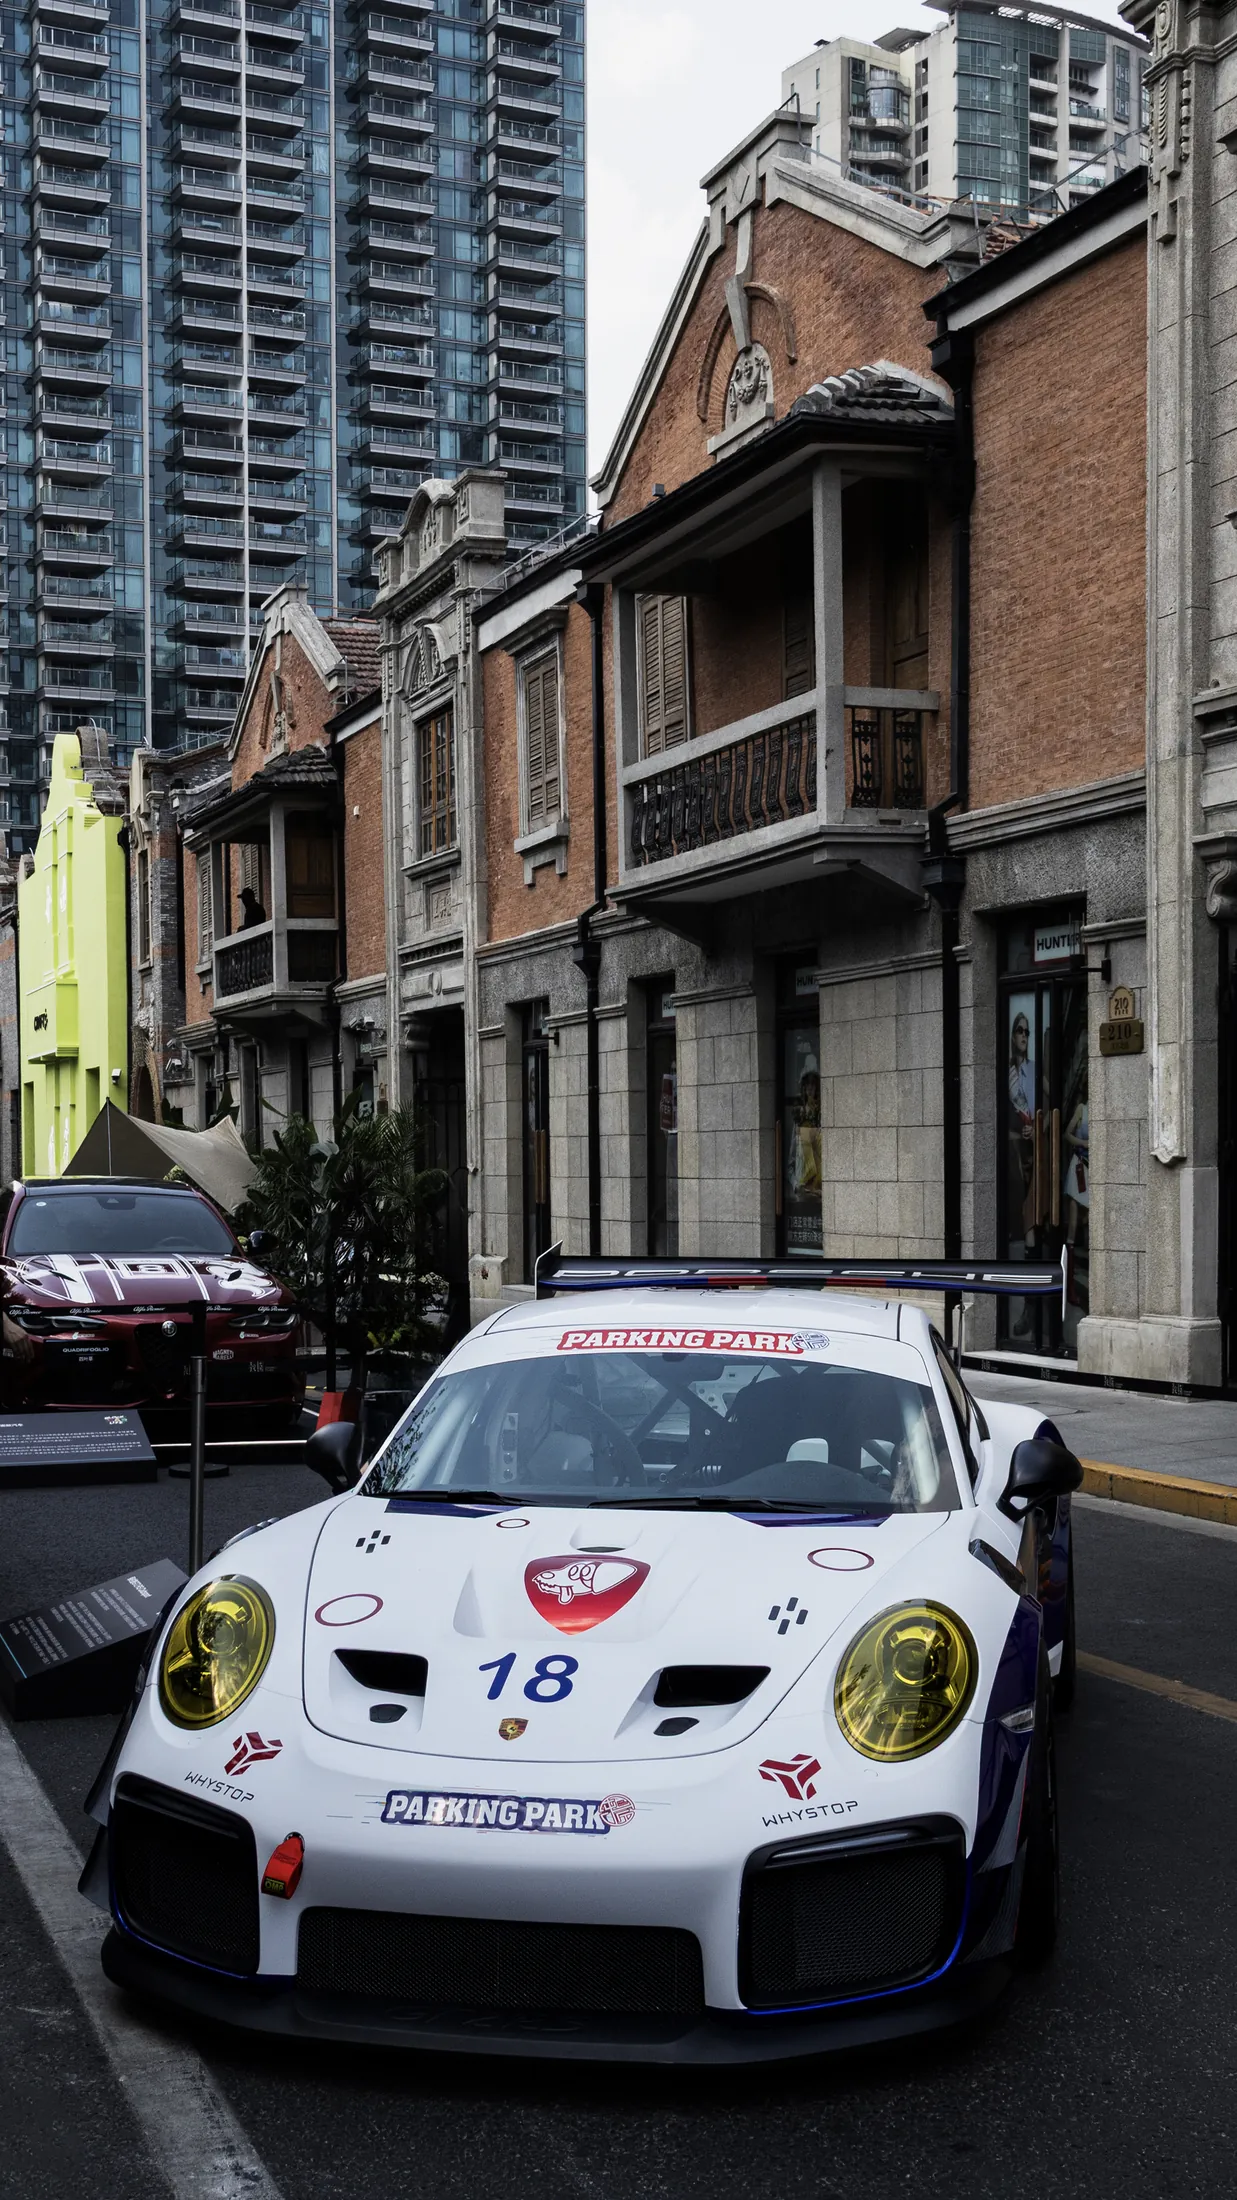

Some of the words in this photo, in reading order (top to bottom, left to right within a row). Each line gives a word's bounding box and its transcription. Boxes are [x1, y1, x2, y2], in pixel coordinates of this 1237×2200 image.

[1115, 997, 1129, 1010] 210
[1108, 1024, 1132, 1040] 210
[563, 1331, 705, 1348] PARKING
[710, 1332, 799, 1352] PARK
[479, 1652, 579, 1703] 18
[184, 1771, 255, 1803] WHYSTOP
[386, 1795, 518, 1826] PARKING
[523, 1801, 606, 1830] PARK
[762, 1800, 858, 1827] WHYSTOP
[264, 1880, 284, 1892] OMP
